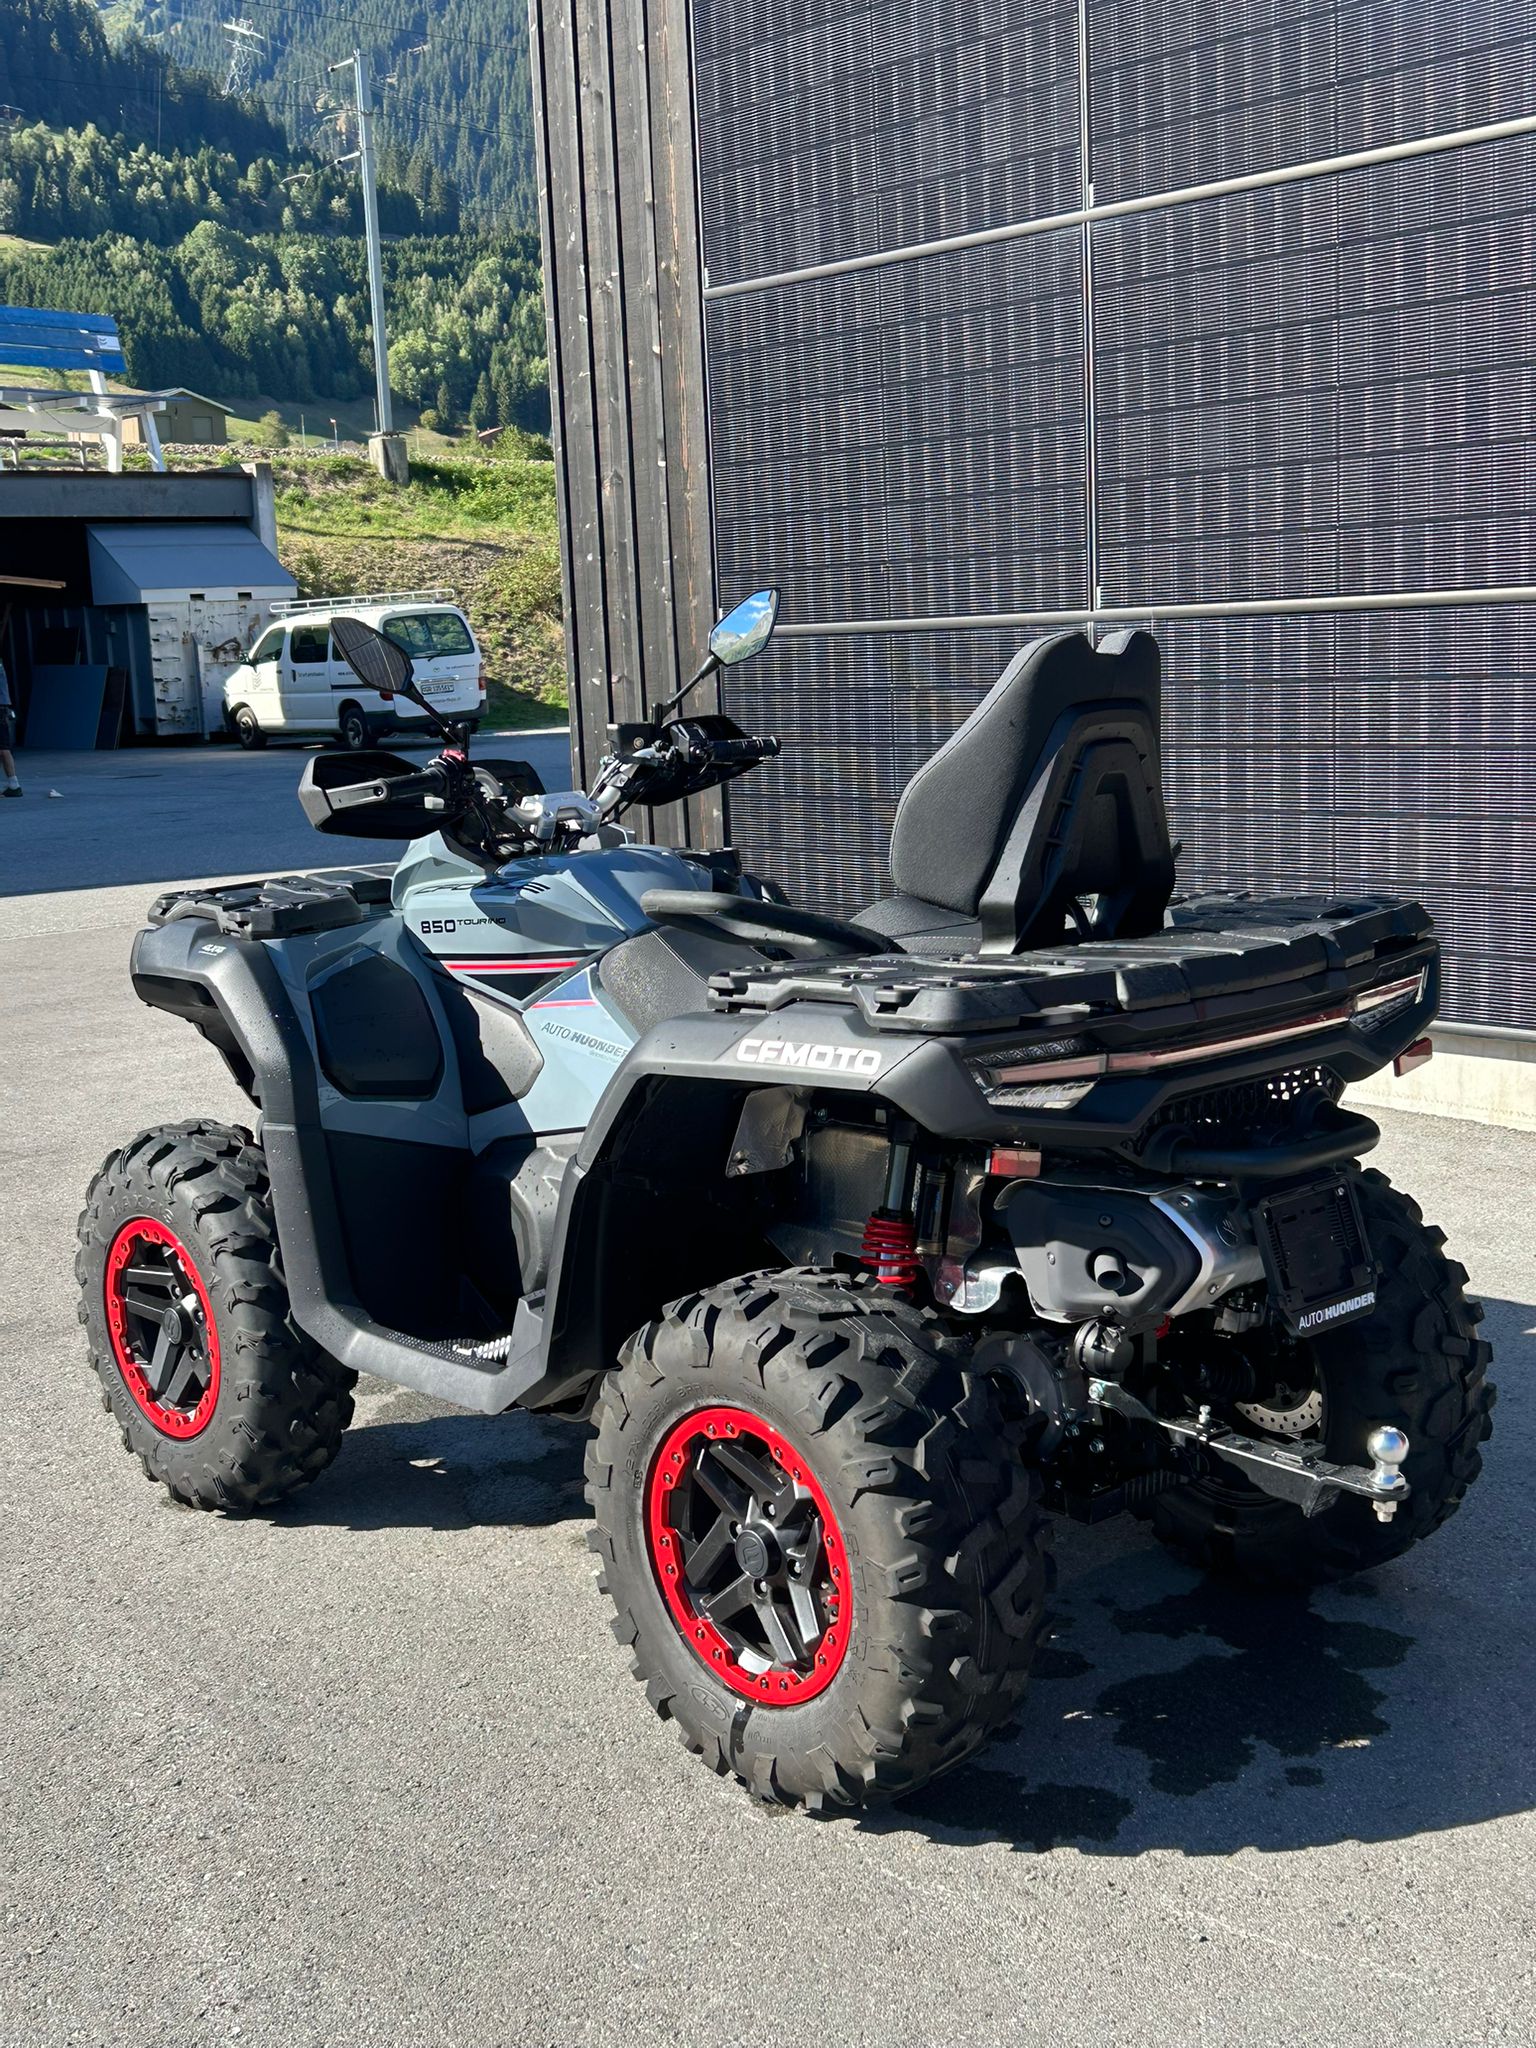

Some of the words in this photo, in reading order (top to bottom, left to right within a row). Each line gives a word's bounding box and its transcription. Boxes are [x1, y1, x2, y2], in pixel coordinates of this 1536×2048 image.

[420, 919, 456, 934] 850
[541, 1022, 571, 1039] AUTO
[737, 1038, 882, 1075] CFMOTO
[1299, 1310, 1323, 1330] AUTO
[1324, 1291, 1375, 1320] HUONDER
